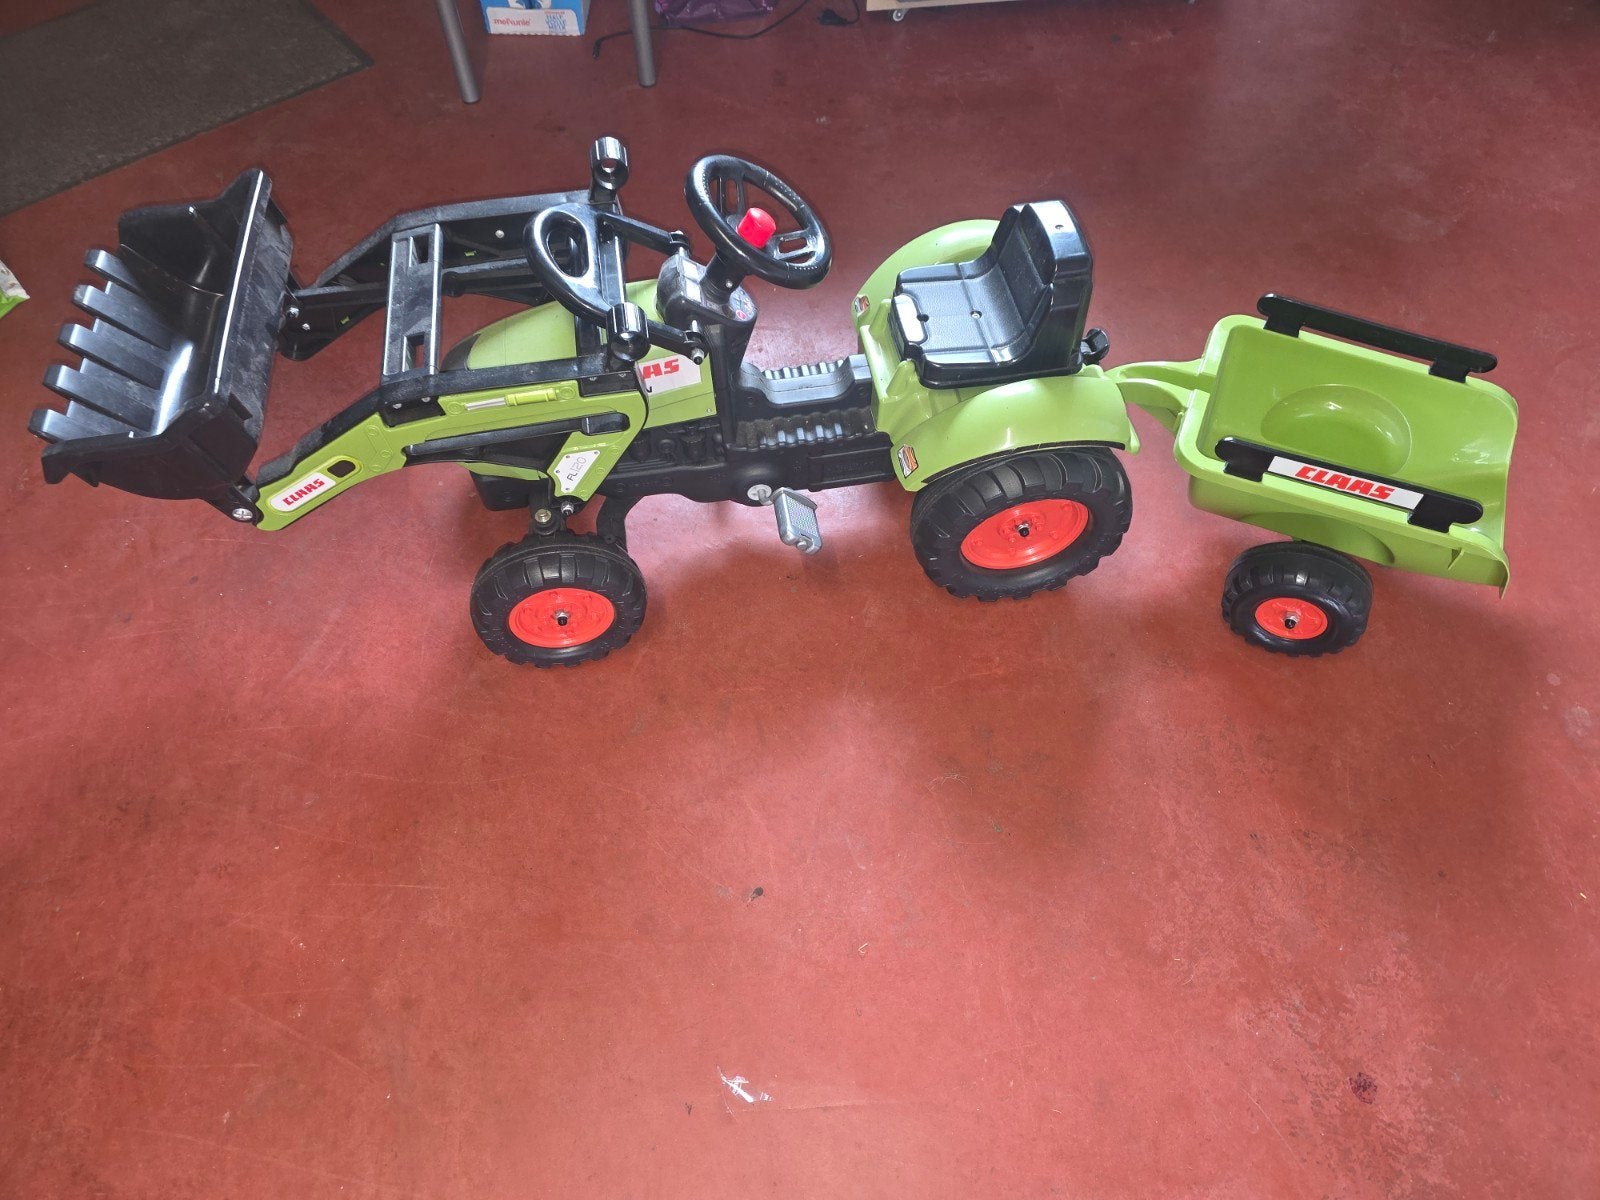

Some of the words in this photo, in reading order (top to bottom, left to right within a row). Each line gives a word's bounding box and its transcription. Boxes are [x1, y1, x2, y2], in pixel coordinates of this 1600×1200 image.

[566, 456, 587, 481] FL120
[1294, 465, 1396, 500] CLAAS
[282, 478, 325, 506] CLAAS
